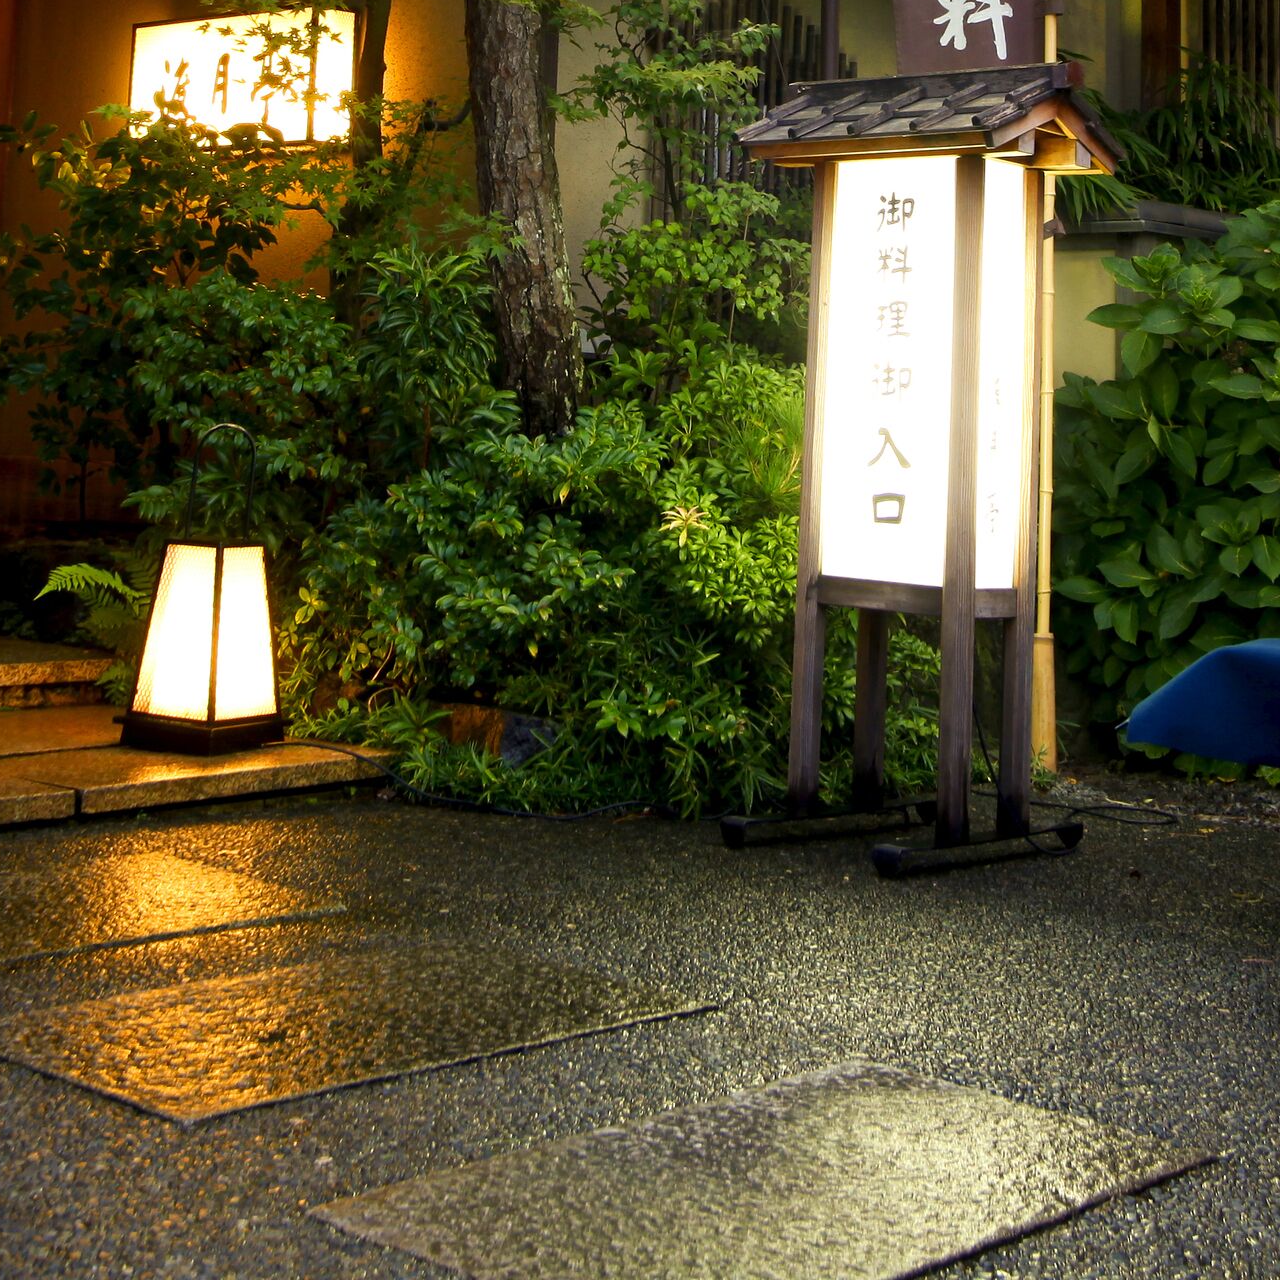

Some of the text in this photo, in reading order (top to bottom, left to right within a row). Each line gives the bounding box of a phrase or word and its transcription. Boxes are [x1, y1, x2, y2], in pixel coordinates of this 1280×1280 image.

[867, 190, 916, 525] 御料理御入口
